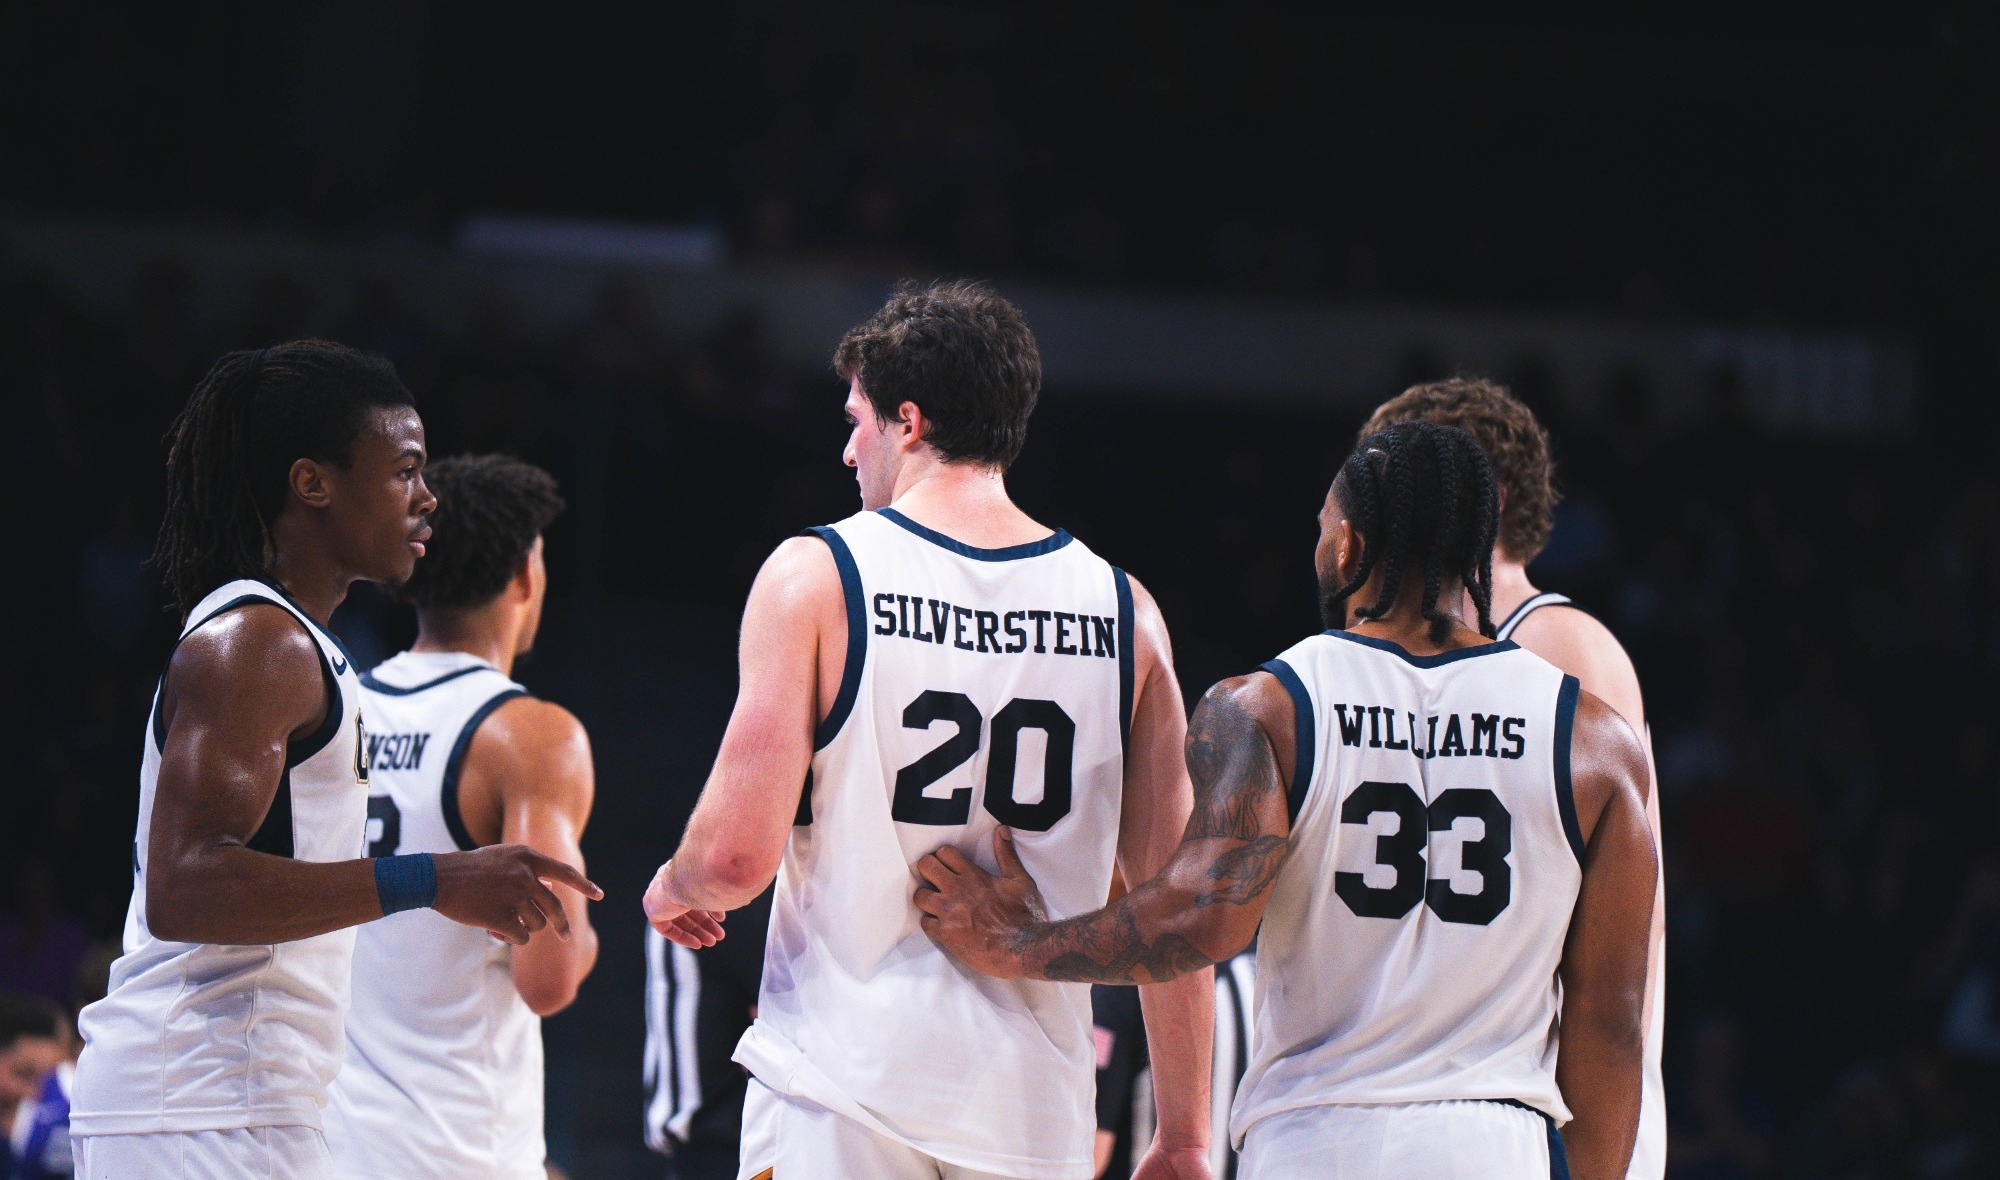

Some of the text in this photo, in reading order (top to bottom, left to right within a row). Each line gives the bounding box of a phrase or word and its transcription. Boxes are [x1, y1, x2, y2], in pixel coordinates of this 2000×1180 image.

[873, 592, 1116, 659] SILVERSTEIN
[365, 731, 431, 770] NSON
[891, 689, 1076, 832] 20
[1333, 703, 1526, 760] WILLIAMS
[1334, 780, 1512, 927] 33
